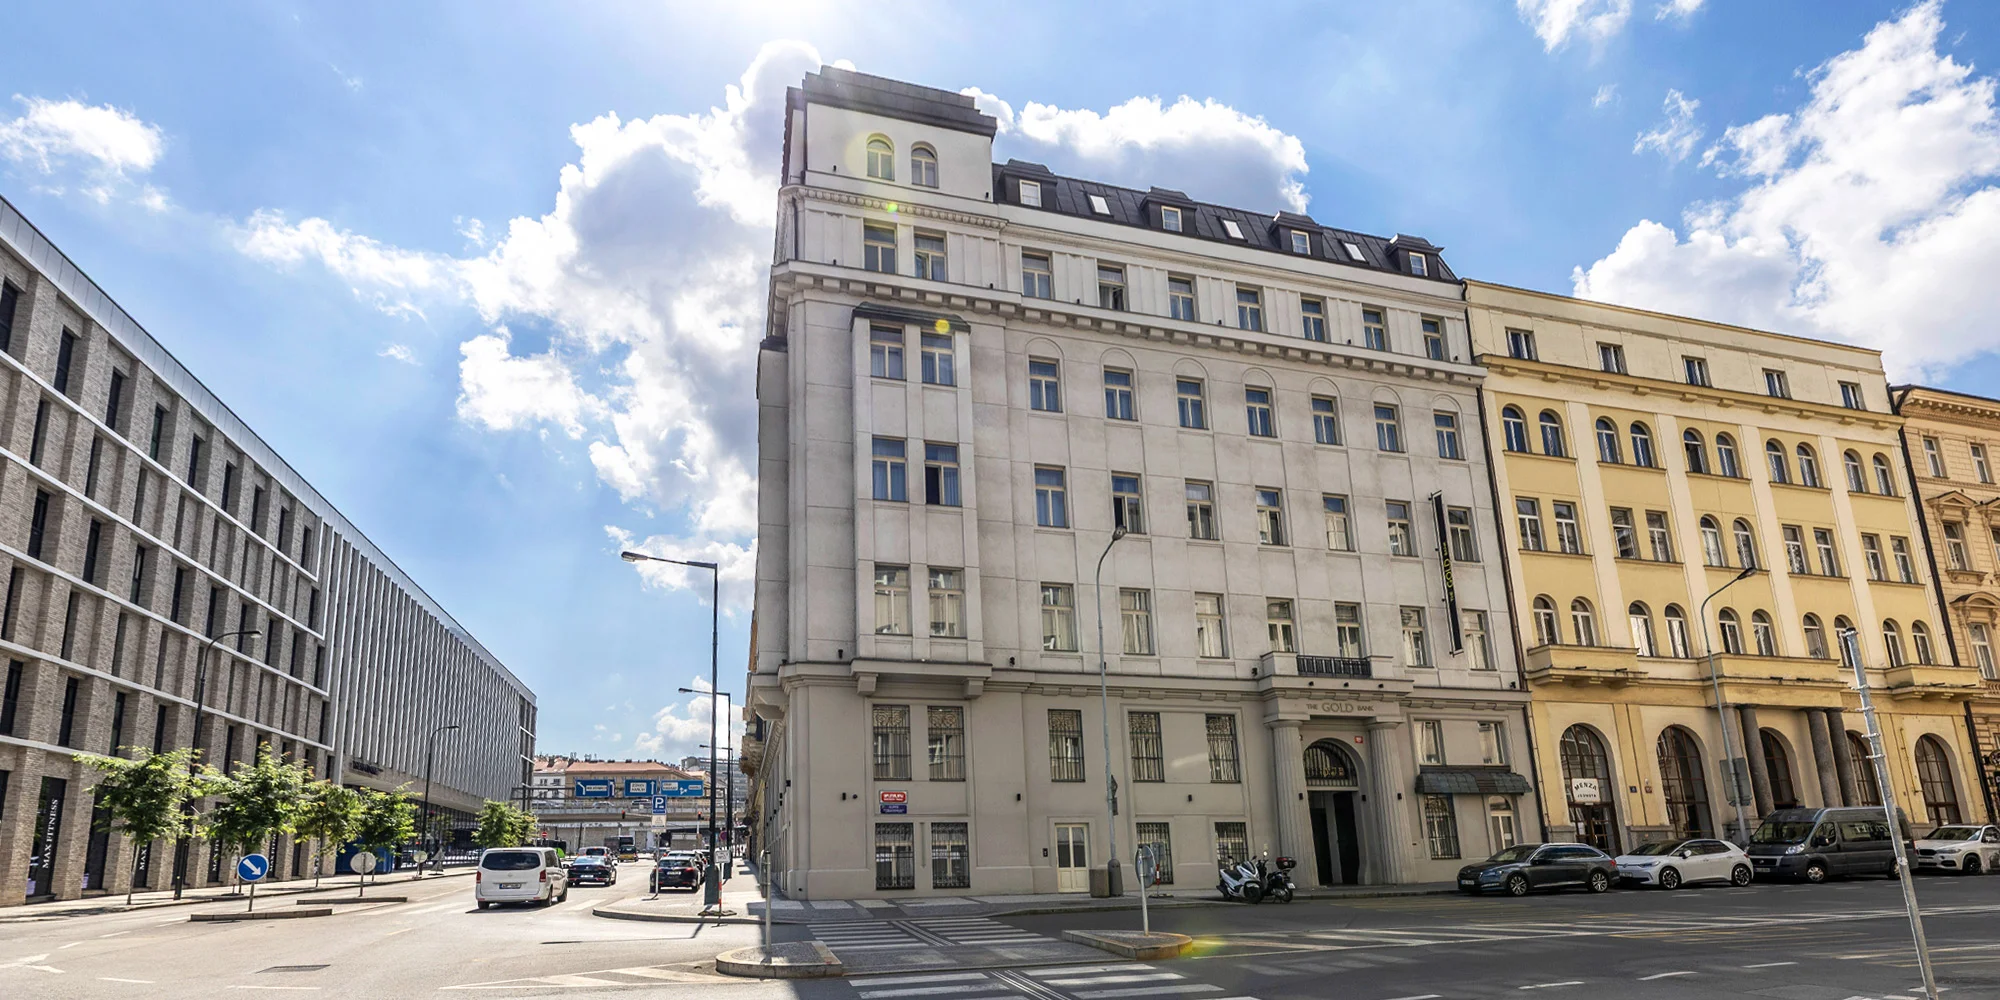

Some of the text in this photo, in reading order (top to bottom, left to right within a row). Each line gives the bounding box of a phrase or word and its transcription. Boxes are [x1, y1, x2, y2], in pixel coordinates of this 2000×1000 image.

[1444, 559, 1454, 588] GOLD
[1321, 702, 1354, 713] GOLD
[1574, 782, 1597, 791] MENZA
[42, 798, 58, 869] MAX FITNESS
[139, 849, 147, 870] MAX
